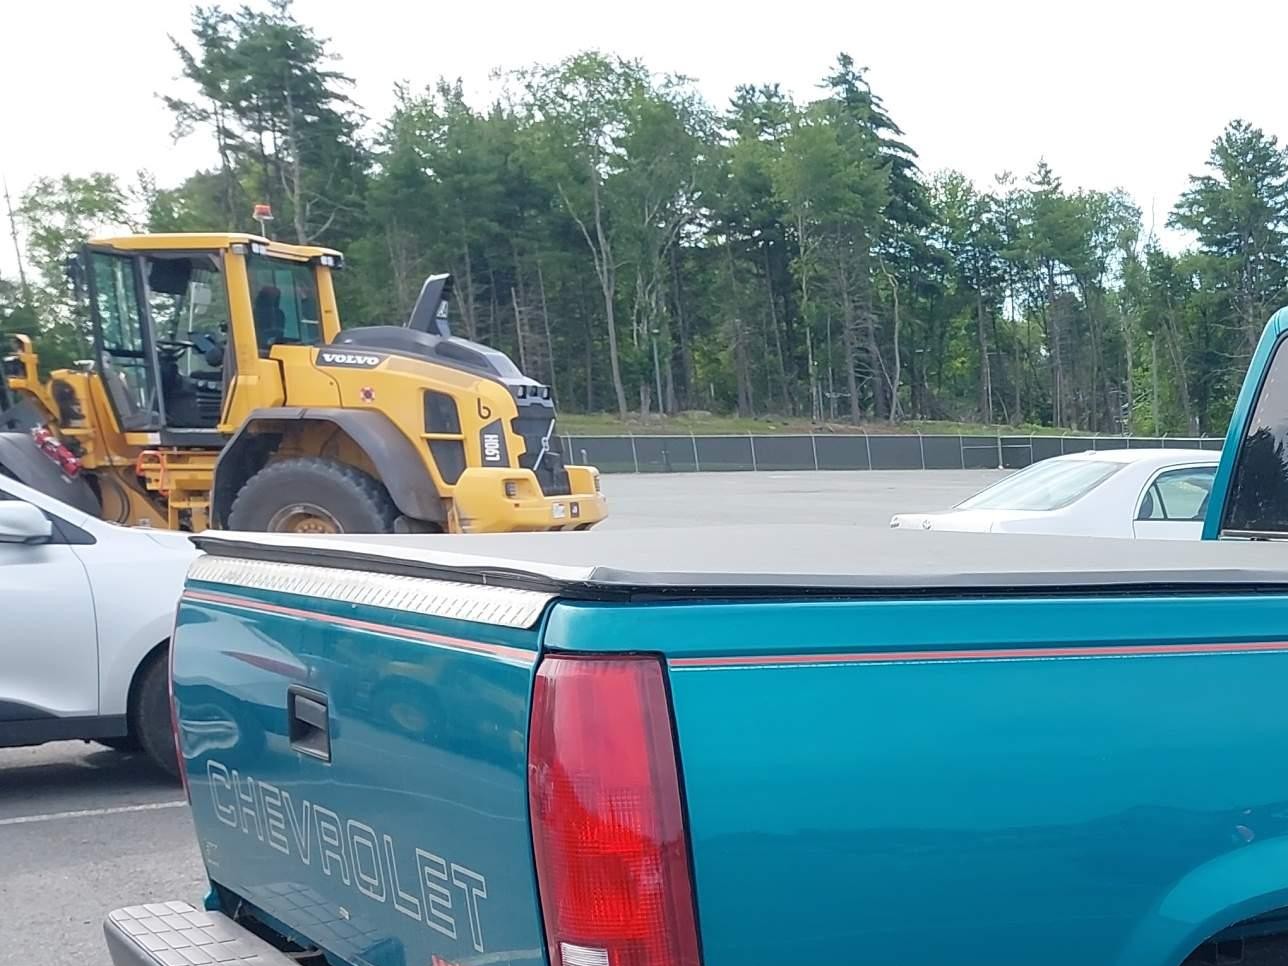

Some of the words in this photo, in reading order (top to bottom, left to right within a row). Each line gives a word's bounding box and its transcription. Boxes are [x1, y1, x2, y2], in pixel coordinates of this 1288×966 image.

[322, 353, 380, 366] VOLVO
[484, 434, 501, 461] L90H
[206, 759, 488, 953] CHEVROLET
